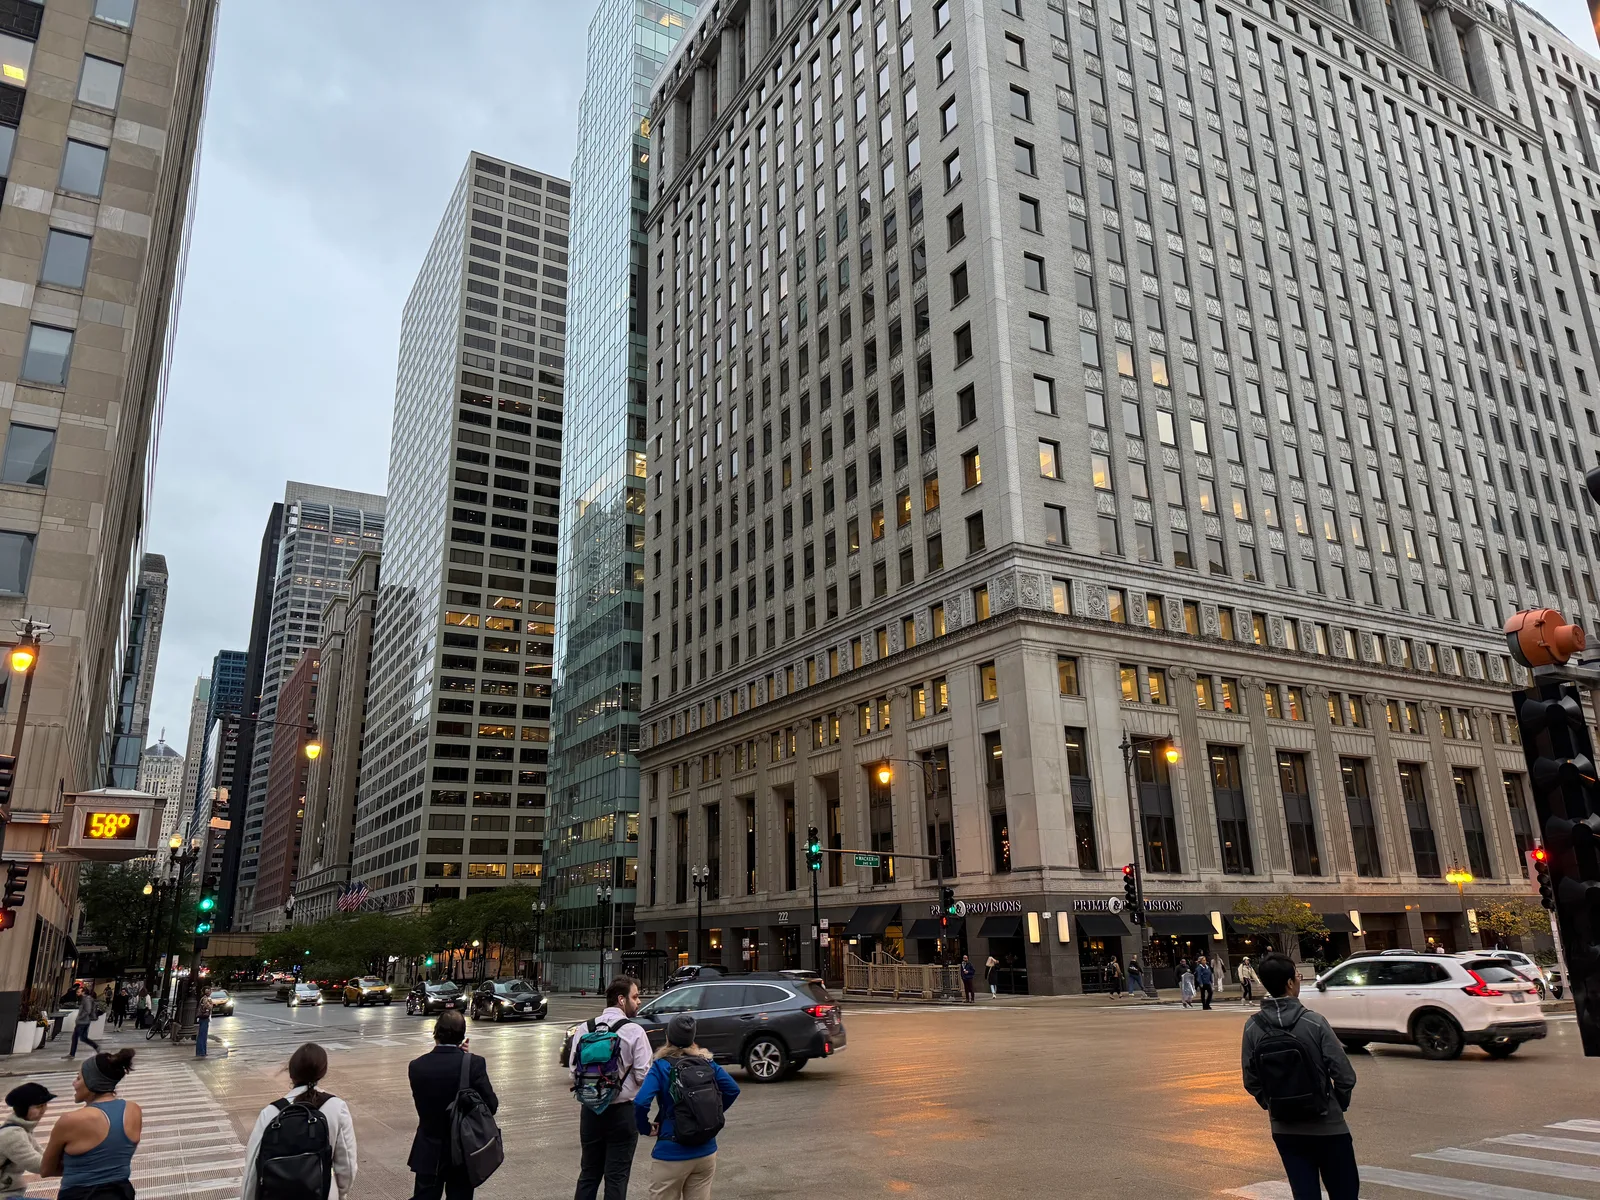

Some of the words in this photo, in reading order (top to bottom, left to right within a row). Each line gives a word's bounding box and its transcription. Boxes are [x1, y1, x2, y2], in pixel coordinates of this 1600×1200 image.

[966, 900, 1022, 914] PROVISIONS
[1073, 899, 1109, 911] PRIME
[778, 911, 789, 921] 222
